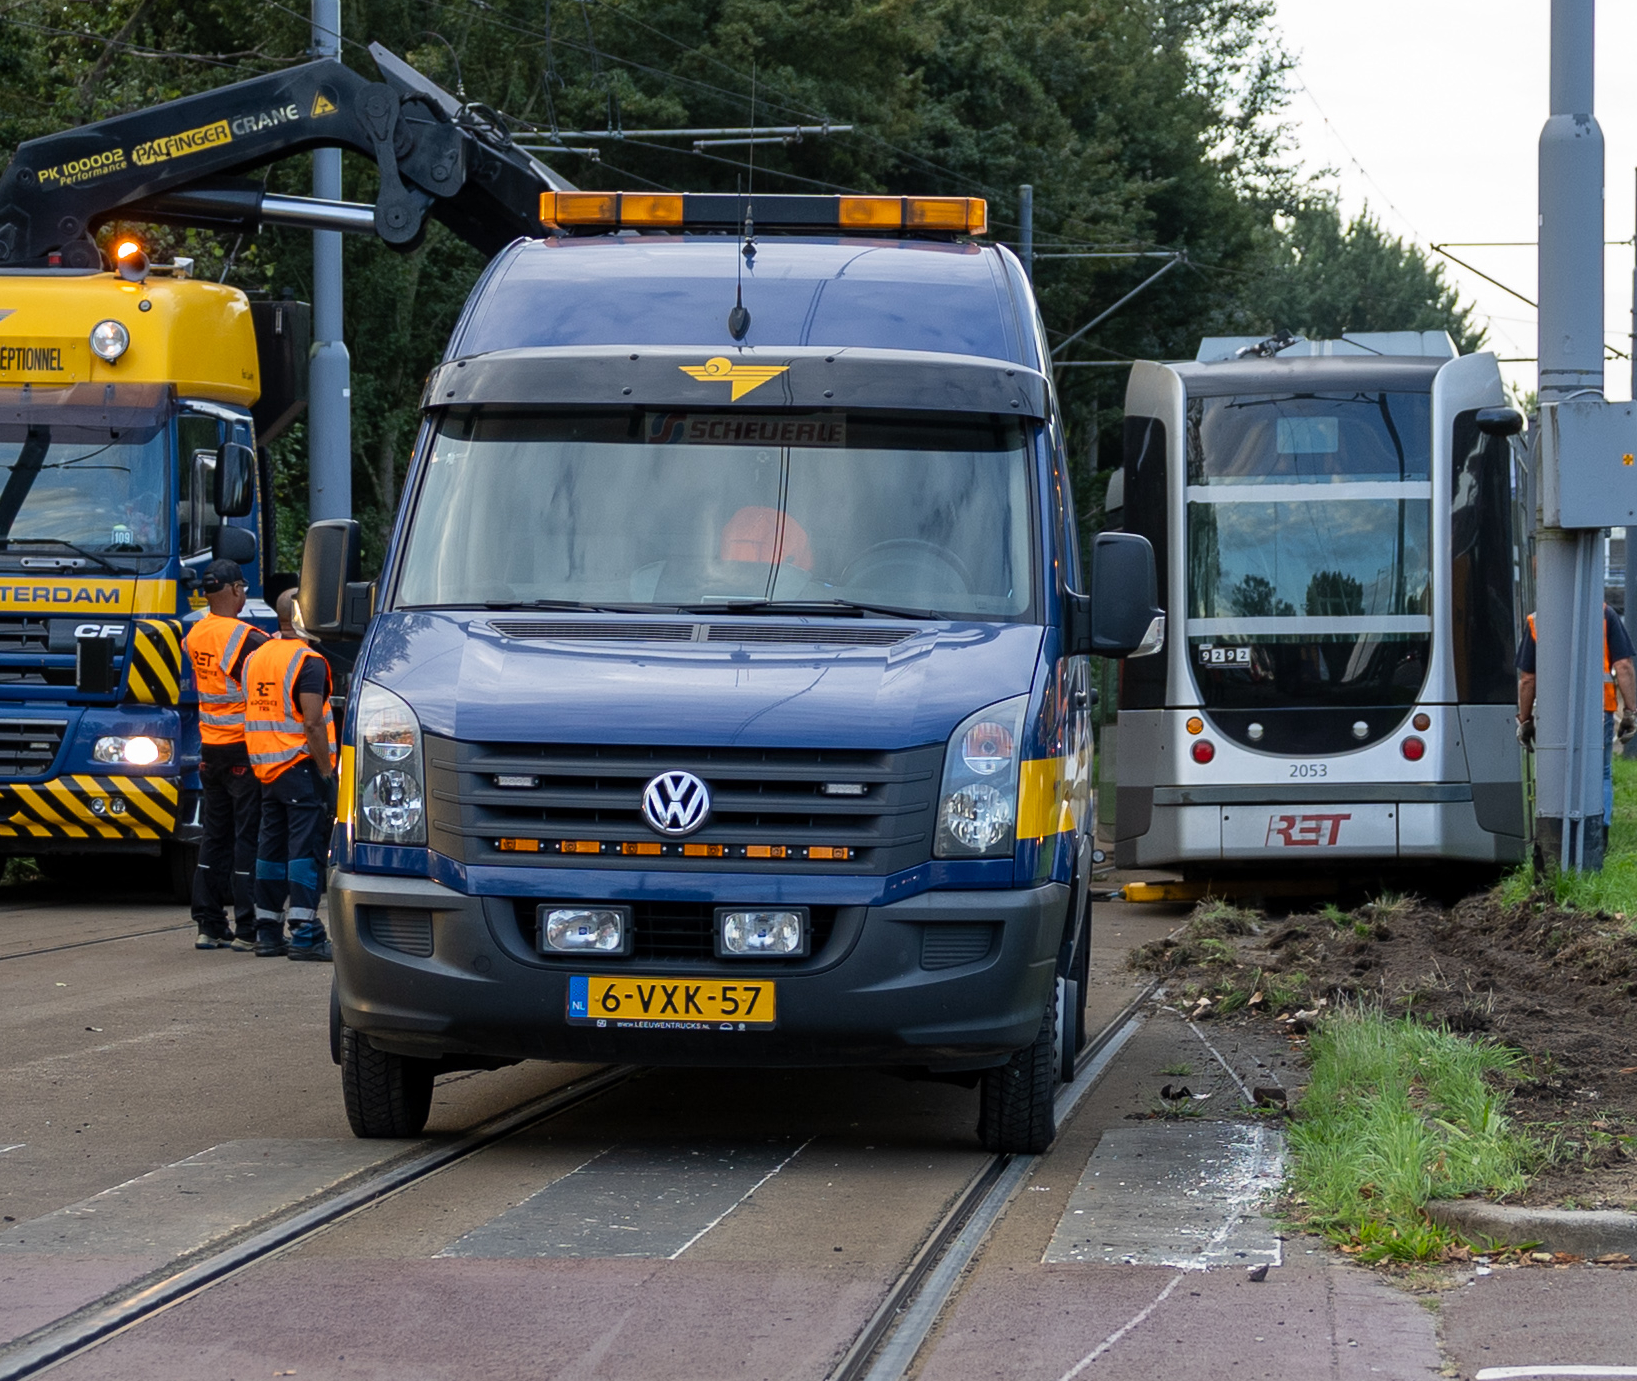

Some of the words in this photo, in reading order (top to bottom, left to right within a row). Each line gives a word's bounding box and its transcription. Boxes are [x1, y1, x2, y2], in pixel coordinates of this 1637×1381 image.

[132, 126, 229, 166] PALFINGER
[232, 104, 300, 137] CRANE
[38, 167, 60, 184] PK
[60, 160, 128, 186] Performance
[690, 420, 843, 443] SCHEUERLE
[115, 532, 131, 544] 109
[74, 624, 125, 637] CF
[1202, 650, 1247, 661] 9292
[1289, 764, 1328, 778] 2053
[1265, 813, 1352, 847] RET
[572, 1001, 585, 1010] NL
[602, 984, 762, 1015] 6-VXK-57
